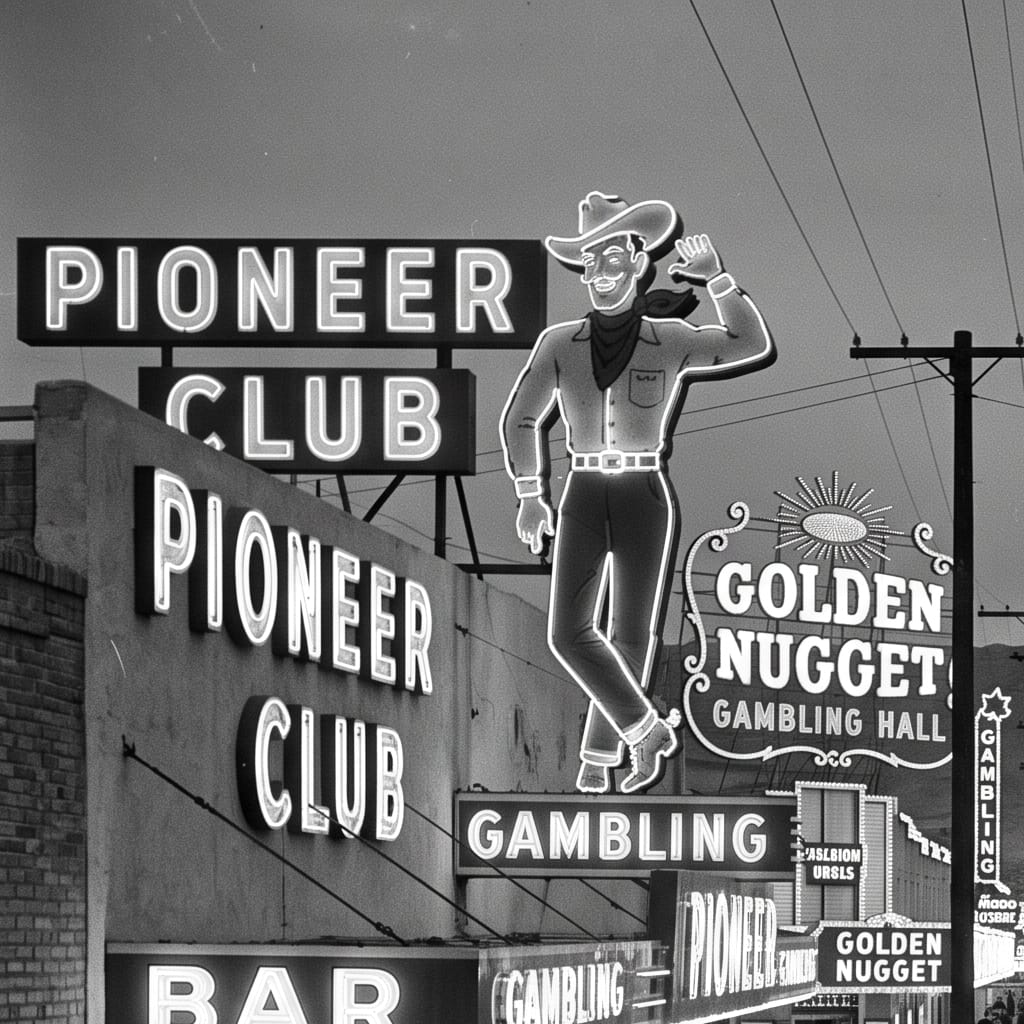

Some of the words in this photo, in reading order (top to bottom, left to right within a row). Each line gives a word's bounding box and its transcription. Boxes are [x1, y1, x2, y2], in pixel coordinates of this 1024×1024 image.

[45, 246, 514, 332] PIONEER
[165, 374, 442, 462] CLUB
[153, 468, 433, 695] PIONEER
[716, 562, 944, 632] GOLDEN
[716, 627, 944, 697] NUGGET
[713, 699, 862, 736] GAMBLING
[878, 710, 946, 742] HALL
[254, 697, 405, 842] CLUB
[980, 729, 995, 873] GAMBLING
[467, 810, 767, 863] GAMBLING
[836, 931, 942, 956] GOLDEN
[836, 959, 942, 982] NUGGET
